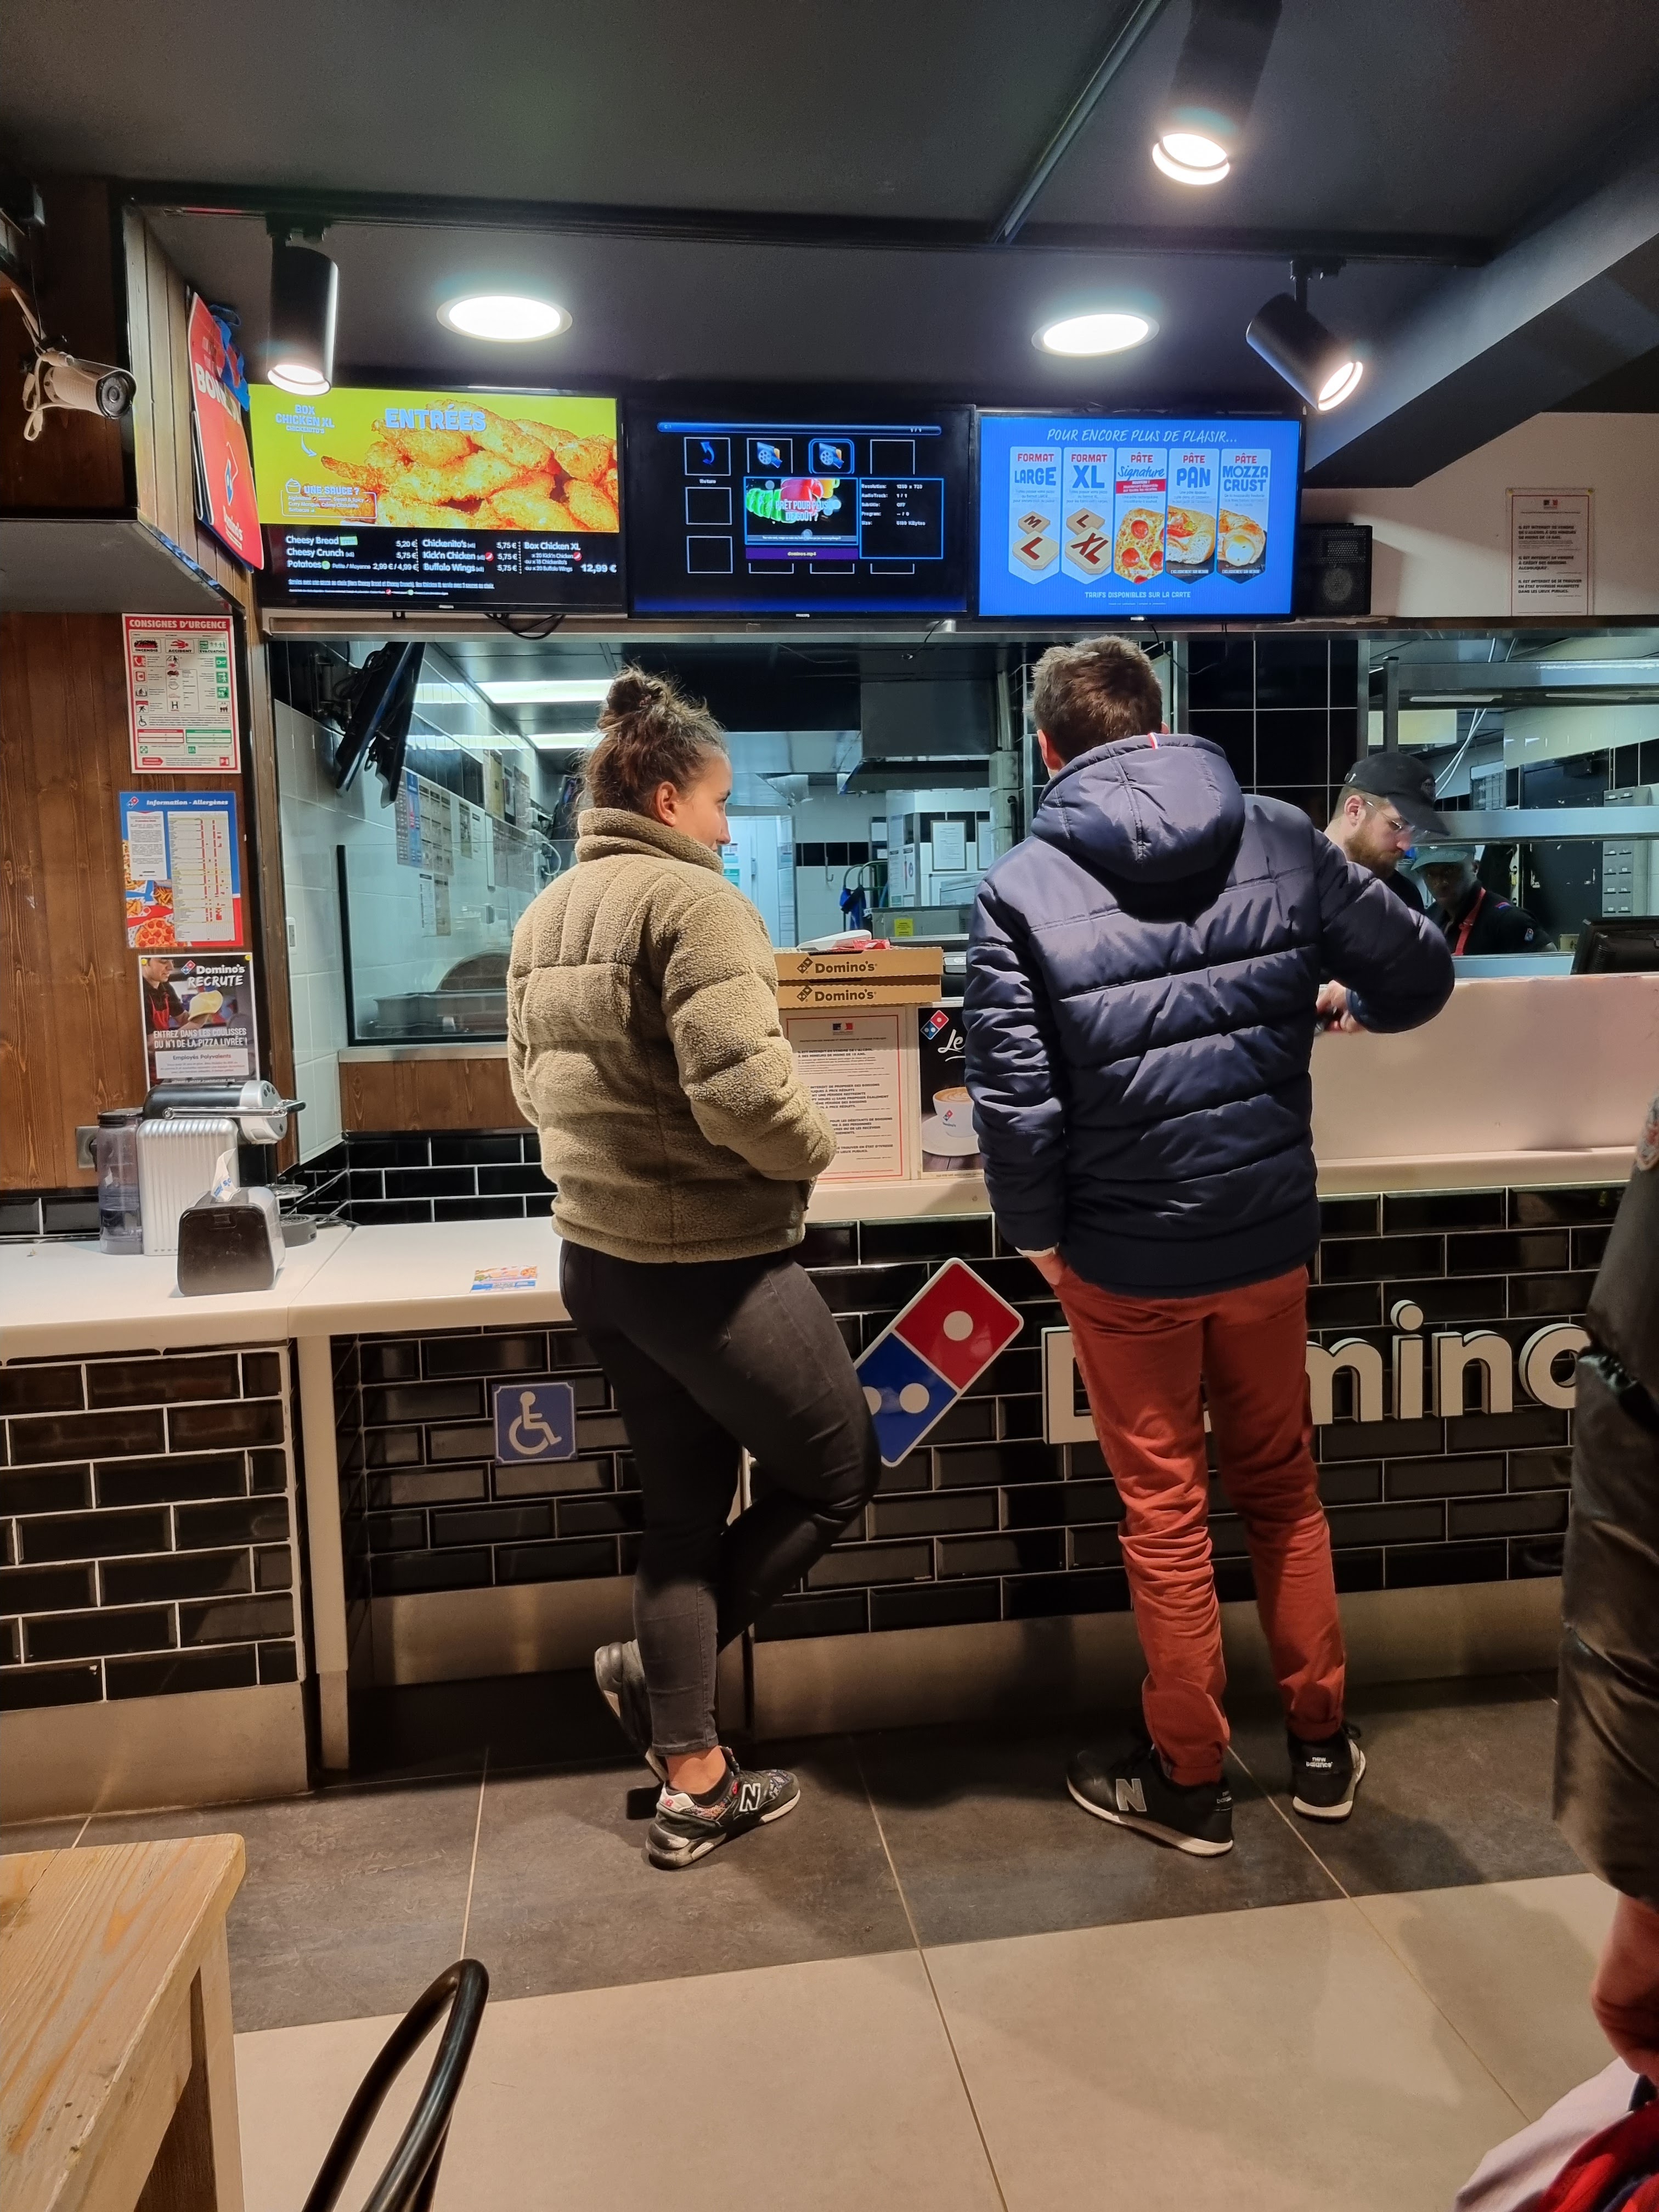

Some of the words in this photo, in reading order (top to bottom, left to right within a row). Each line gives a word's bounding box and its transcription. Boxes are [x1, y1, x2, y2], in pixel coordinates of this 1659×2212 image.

[295, 404, 315, 415] BOX
[275, 413, 320, 426] CHICKEN
[321, 417, 335, 428] XL
[385, 404, 487, 431] ENTRÉES
[1047, 428, 1079, 442] POUR
[1081, 428, 1129, 443] ENCORE
[1130, 429, 1160, 443] PLUS
[1163, 430, 1180, 442] DE
[1182, 430, 1238, 443] PLAISIR...
[1017, 453, 1055, 462] FORMAT
[1071, 454, 1108, 462] FORMAT
[1130, 452, 1153, 463] PÂTE
[1183, 452, 1205, 464] PÂTE
[1235, 452, 1257, 464] PÂTE
[1014, 466, 1057, 486] LARGE
[1071, 465, 1105, 489] XL
[1118, 465, 1165, 481] Signature
[1176, 466, 1211, 488] PAN
[1222, 465, 1269, 478] MOZZA
[303, 486, 322, 494] UNE
[324, 486, 353, 495] SAUCE
[354, 487, 360, 496] ?
[1223, 478, 1267, 492] CRUST
[775, 499, 792, 510] PRÊT
[793, 500, 810, 510] POUR
[812, 500, 828, 510] PLUS
[785, 512, 794, 521] DE
[796, 511, 813, 521] GOÛT
[814, 512, 819, 522] ?
[1024, 515, 1042, 528] M
[1076, 514, 1090, 528] L
[286, 535, 314, 546] Cheesy
[315, 535, 339, 545] Bread
[396, 540, 410, 548] 5,20
[421, 538, 467, 548] Chickenito's
[496, 541, 511, 550] 5,75
[523, 541, 539, 550] Box
[540, 542, 569, 550] Chicken
[571, 543, 581, 551] XL
[286, 548, 315, 558] Cheesy
[317, 548, 345, 557] Crunch
[1020, 537, 1043, 561] L
[1070, 532, 1109, 565] XL
[422, 550, 445, 559] Kick'n
[446, 551, 476, 560] Chicken
[496, 553, 512, 561] 5,75
[287, 560, 322, 568] Potatoes
[422, 562, 451, 572] Buffalo
[451, 563, 476, 573] Wings
[580, 563, 608, 574] 12,99
[609, 564, 617, 573] €
[129, 619, 177, 629] CONSIGNES
[179, 620, 227, 629] D'URGENCE
[196, 964, 246, 975] Domino's
[814, 961, 876, 974] Domino's
[188, 975, 244, 987] RECRUTE
[814, 989, 874, 1002] Domino's
[154, 1030, 179, 1039] ENTREZ
[180, 1029, 198, 1037] DANS
[212, 1028, 247, 1036] COULISSES
[154, 1040, 163, 1048] DU
[187, 1039, 197, 1047] LA
[198, 1038, 219, 1047] PIZZA
[221, 1036, 243, 1046] LIVRÉE
[245, 1037, 247, 1046] !
[1041, 1299, 1590, 1445] mino
[739, 1782, 761, 1812] N
[1115, 1778, 1147, 1812] N
